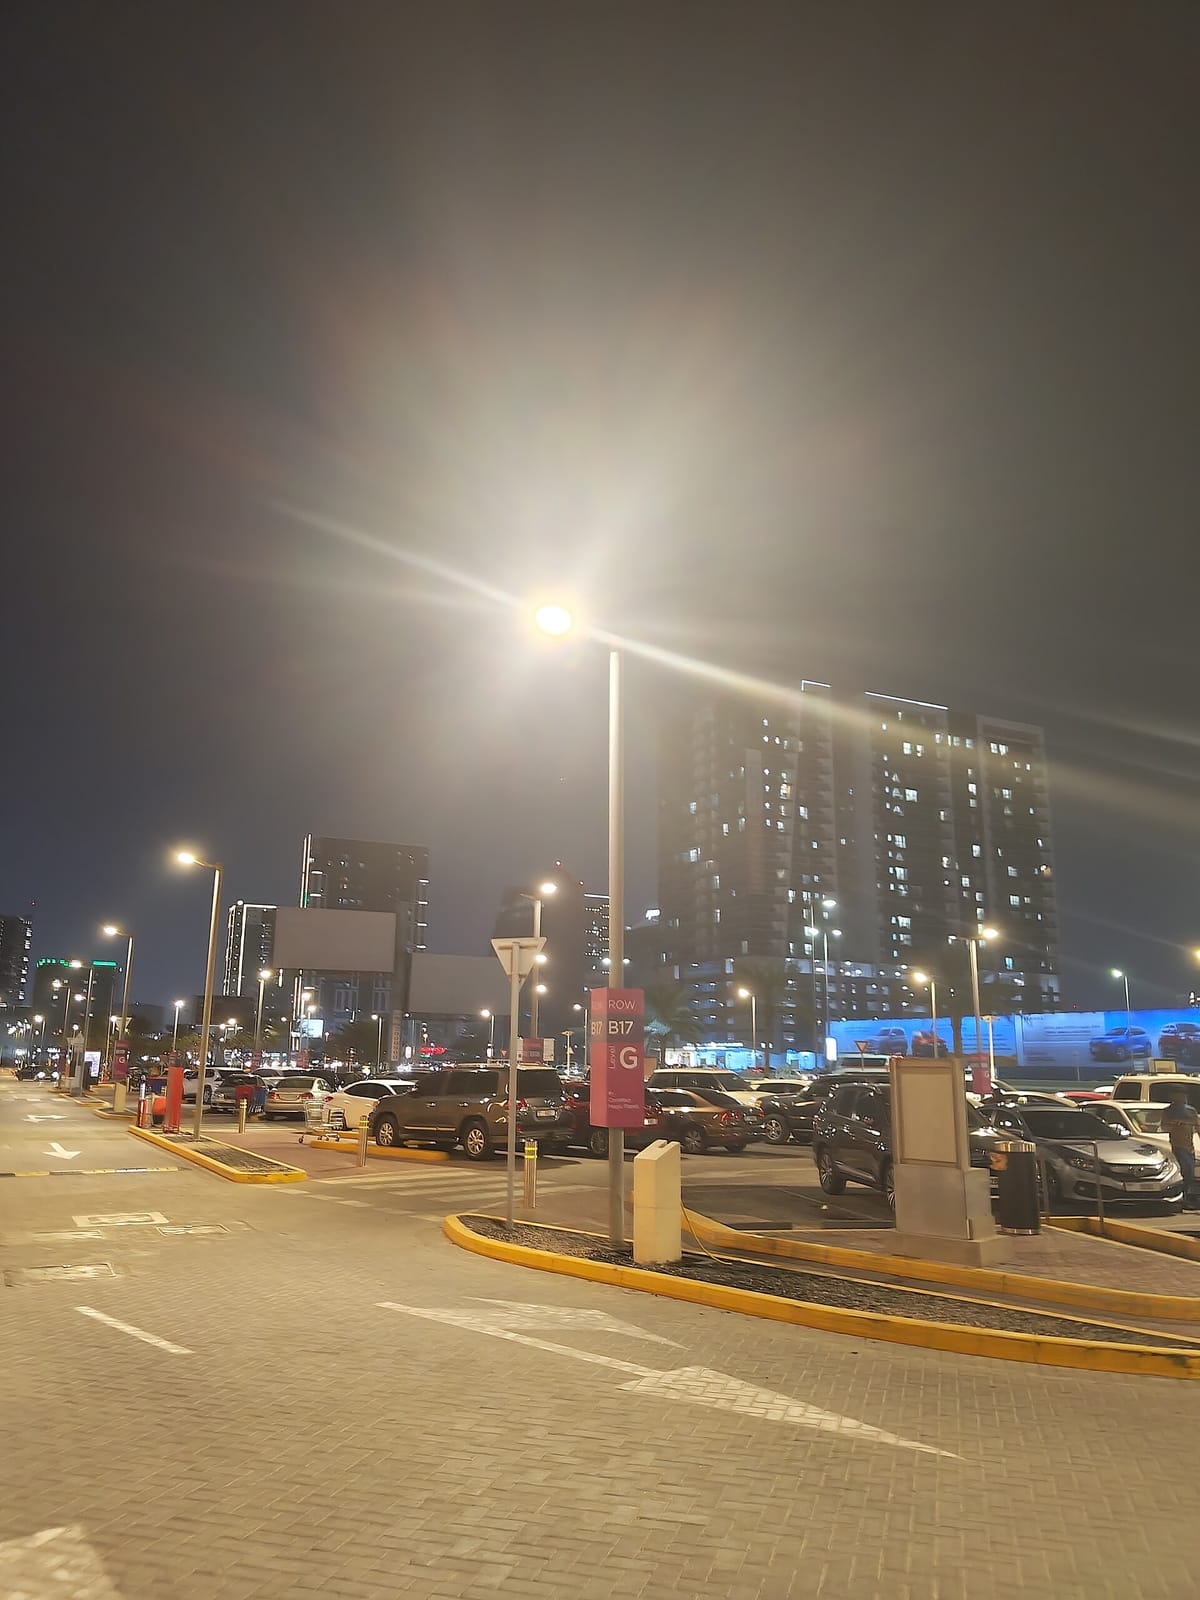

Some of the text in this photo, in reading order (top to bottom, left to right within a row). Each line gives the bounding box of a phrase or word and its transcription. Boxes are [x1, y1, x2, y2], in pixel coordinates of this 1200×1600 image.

[608, 999, 636, 1010] ROW
[591, 1021, 602, 1035] B17
[608, 1020, 634, 1035] B17
[619, 1046, 638, 1070] G
